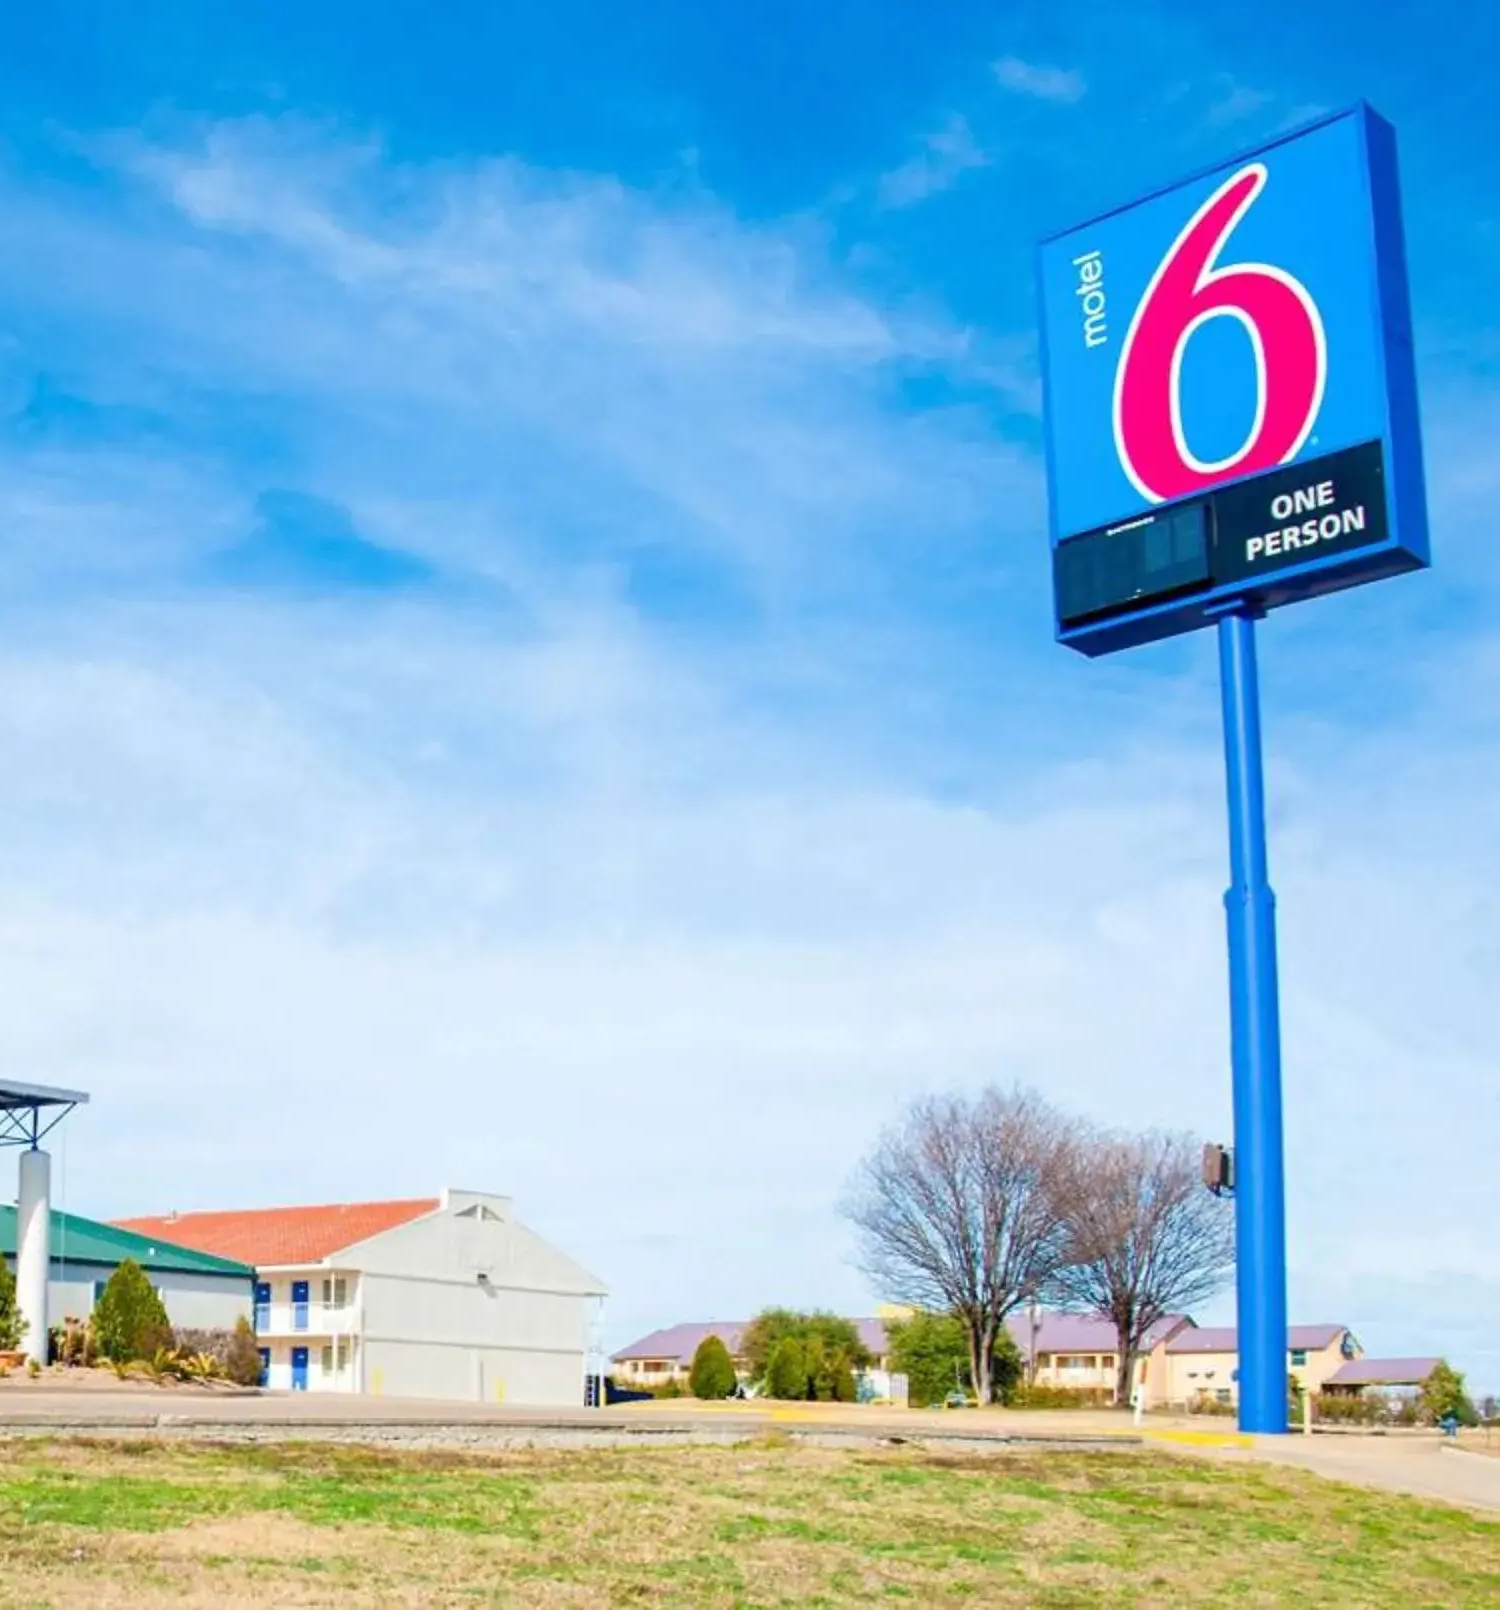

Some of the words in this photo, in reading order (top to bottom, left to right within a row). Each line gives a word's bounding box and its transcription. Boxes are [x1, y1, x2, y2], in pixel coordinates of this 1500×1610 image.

[1072, 250, 1108, 348] motel
[1113, 163, 1327, 504] 6
[1246, 506, 1365, 561] PERSON
[1271, 480, 1335, 519] ONE
